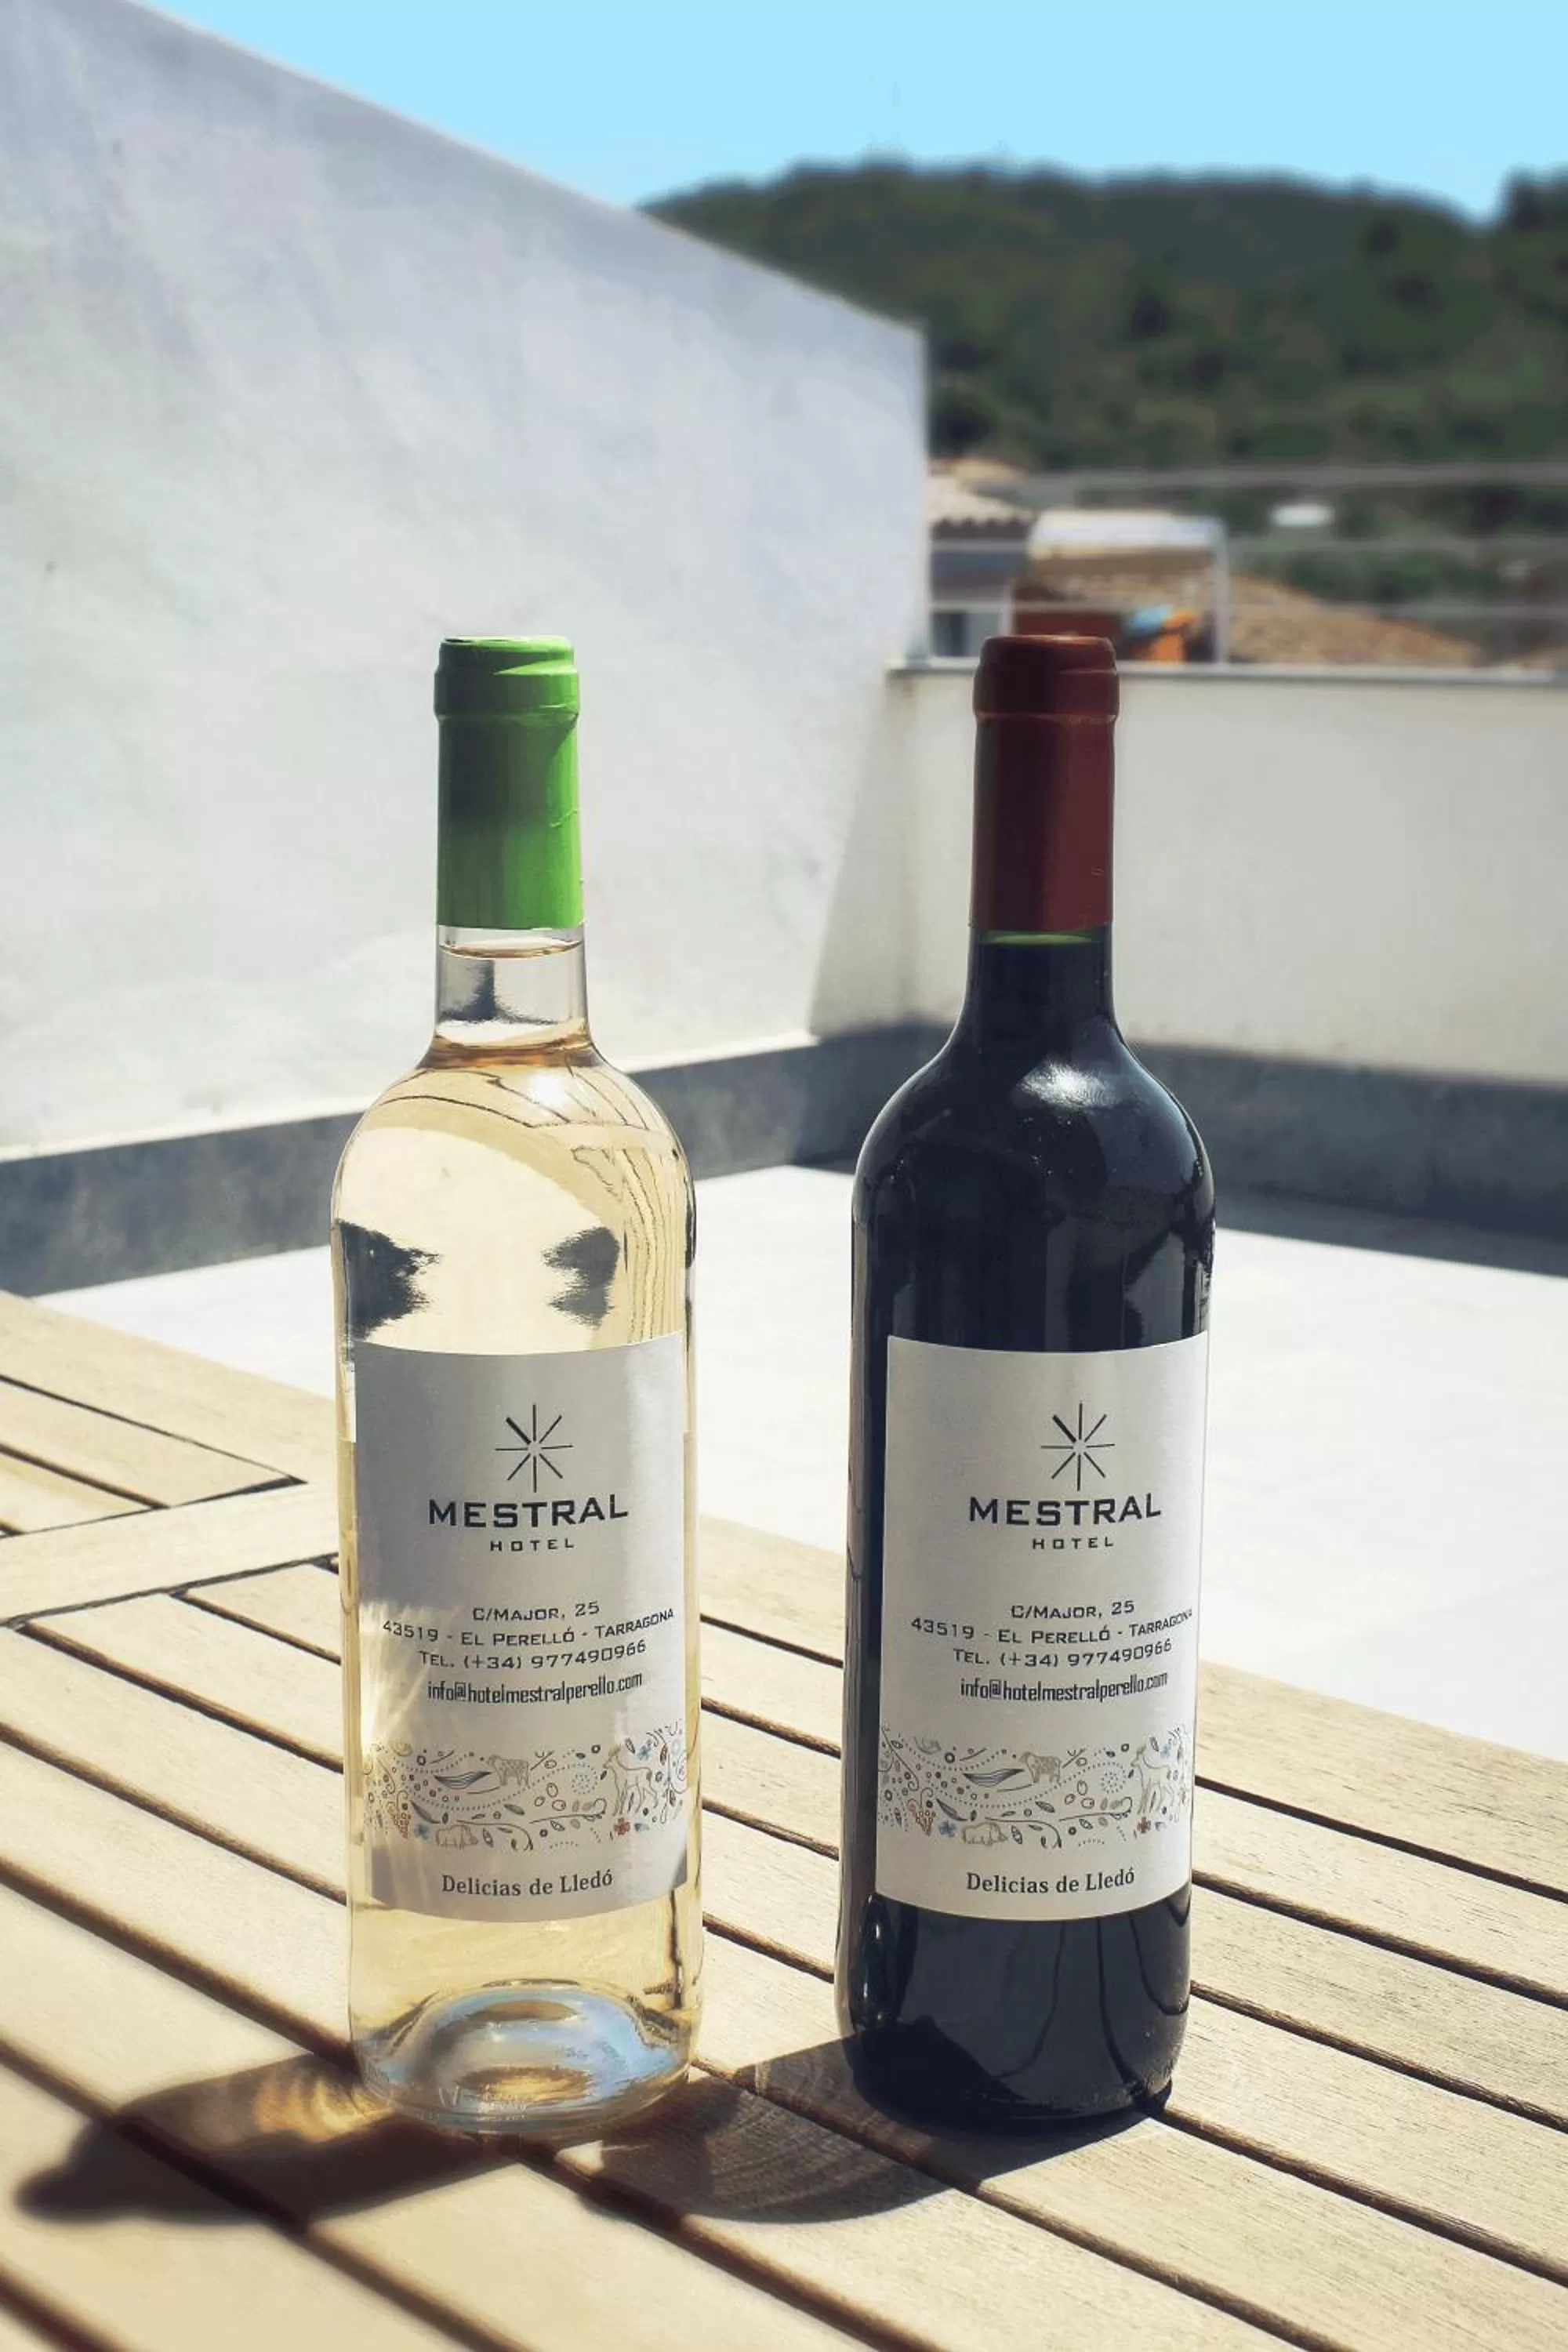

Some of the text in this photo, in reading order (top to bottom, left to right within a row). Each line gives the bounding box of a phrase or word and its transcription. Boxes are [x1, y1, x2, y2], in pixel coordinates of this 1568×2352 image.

[429, 1494, 629, 1527] MESTRAL
[970, 1493, 1161, 1526] MESTRAL
[490, 1538, 574, 1552] HOTEL
[1033, 1537, 1114, 1550] HOTEL
[575, 1601, 600, 1616] 25
[1112, 1600, 1134, 1615] 25
[383, 1620, 438, 1642] 43519
[493, 1627, 575, 1646] PERELLÓ
[594, 1608, 674, 1639] TARRAGONA
[911, 1617, 974, 1639] 43519
[1031, 1626, 1110, 1644] PERELLÓ
[419, 1639, 646, 1669] TEL. (+34) 977490966
[953, 1639, 1172, 1668] TEL. (+34) 977490966
[427, 1671, 642, 1704] info@hotelmestralperello.com
[960, 1671, 1167, 1702] info@hotelmestralperello.com
[442, 1870, 612, 1896] Delicias de Lledó
[967, 1867, 1134, 1893] Delicias de Lledó
